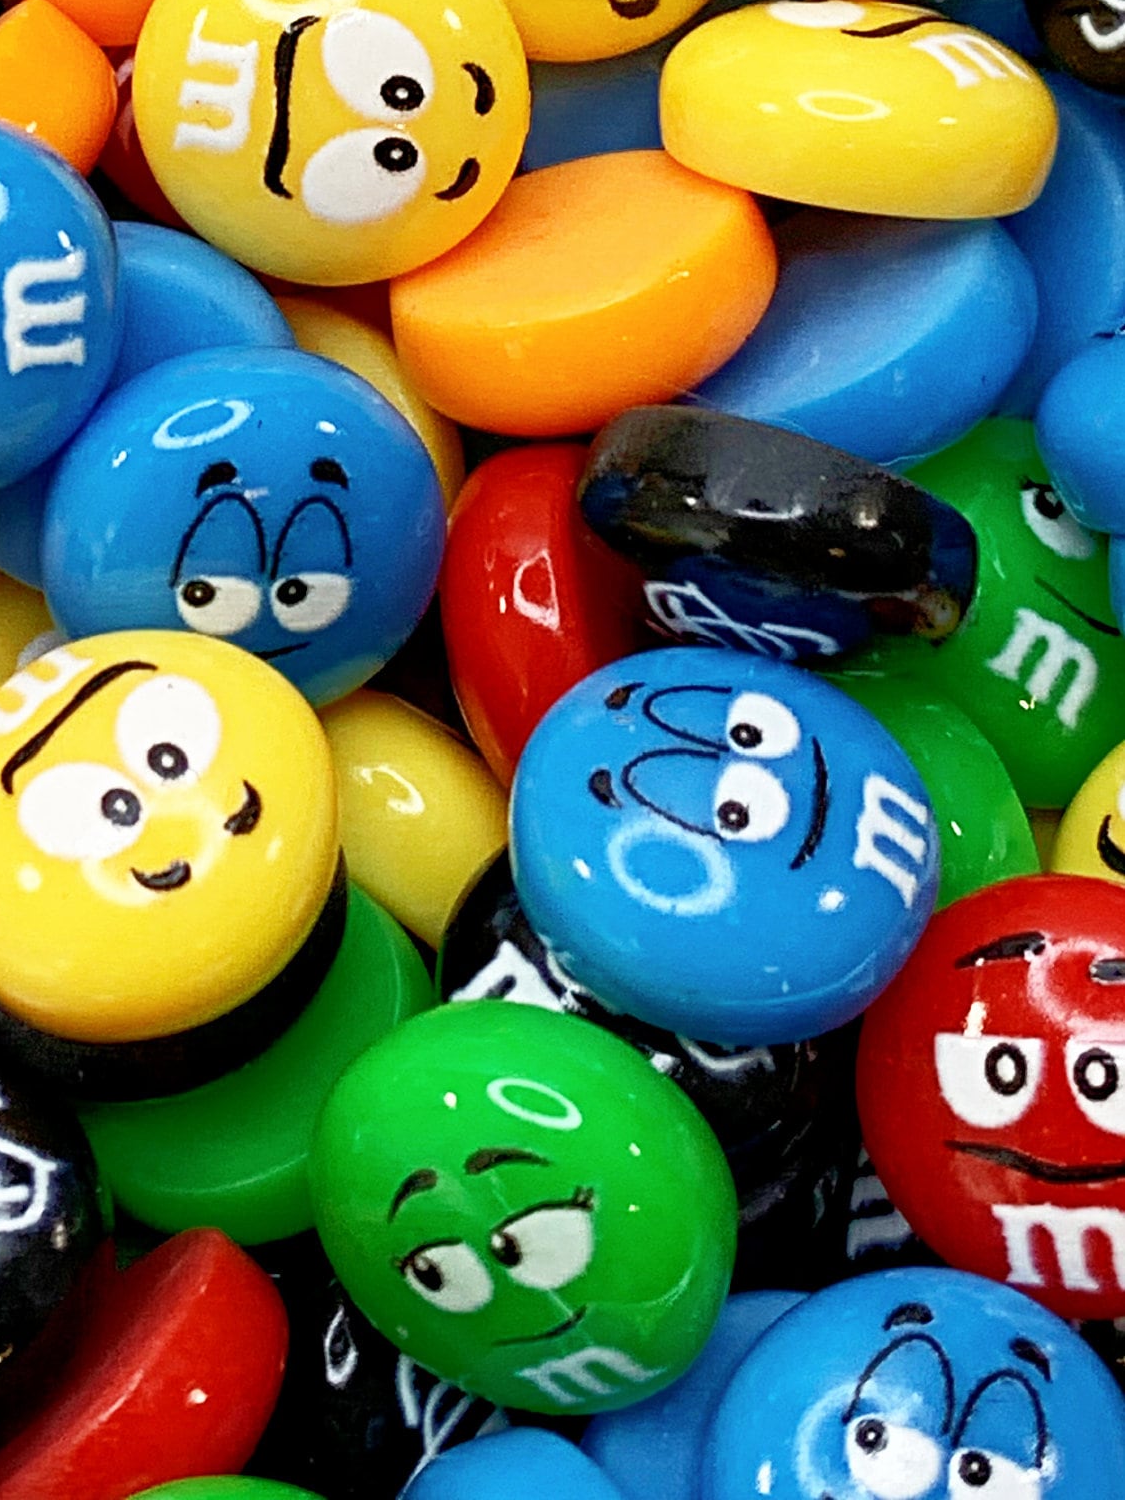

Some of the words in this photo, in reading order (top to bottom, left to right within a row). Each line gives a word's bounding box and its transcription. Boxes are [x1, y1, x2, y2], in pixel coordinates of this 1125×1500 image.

[175, 14, 259, 152] m
[909, 32, 1031, 87] m
[3, 249, 86, 375] m
[986, 606, 1099, 730] m
[854, 774, 927, 909] m
[991, 1202, 1125, 1291] m
[517, 1346, 664, 1403] m
